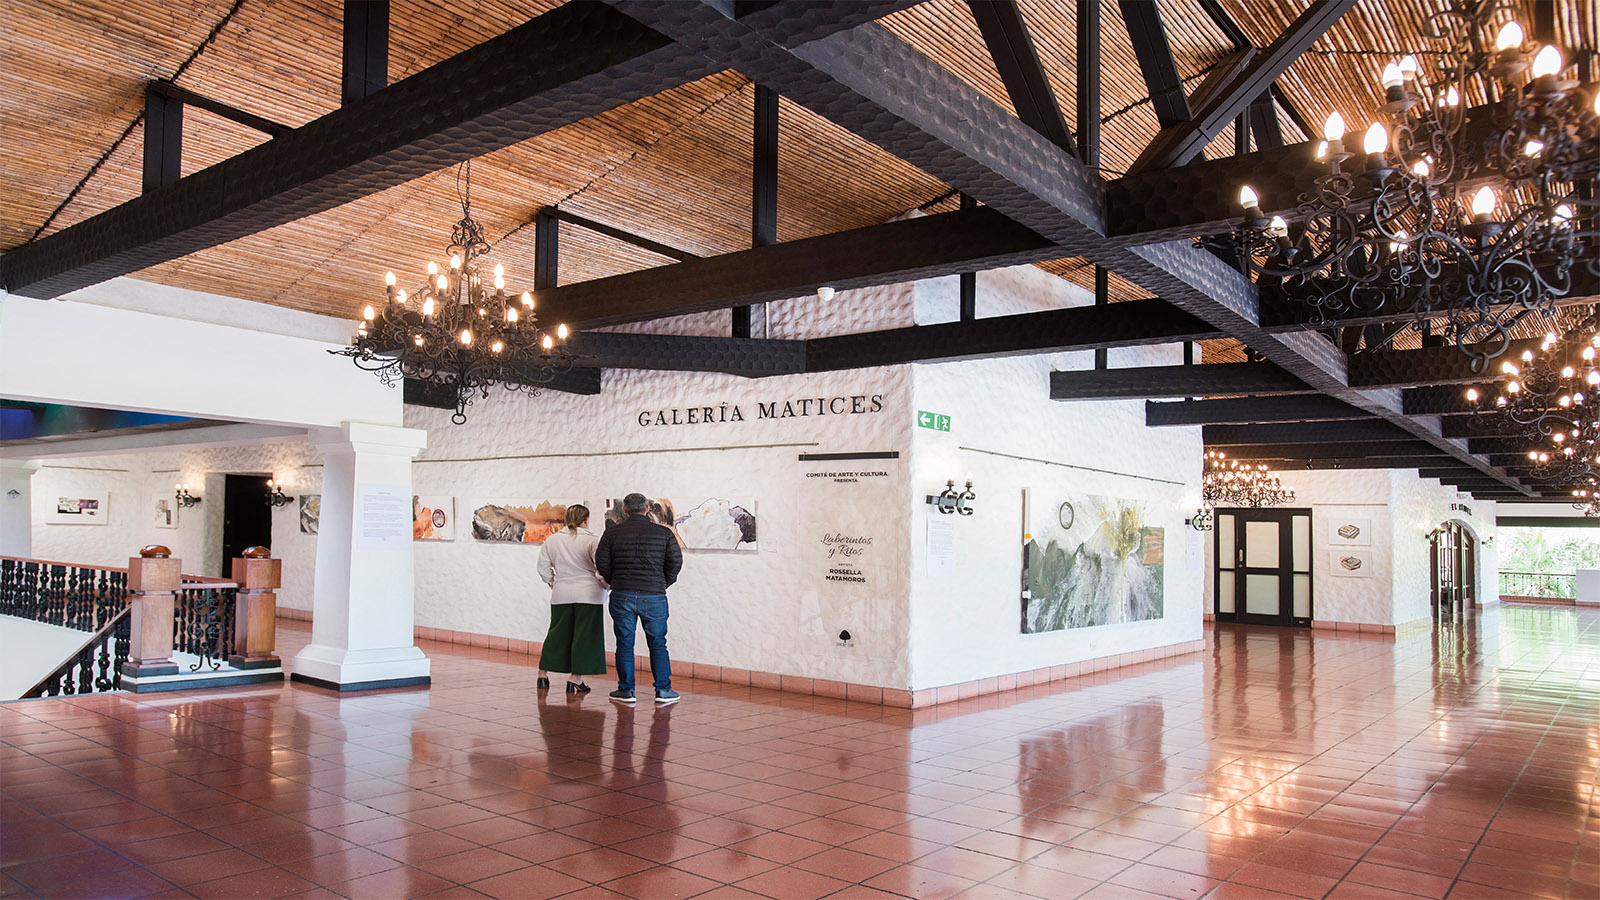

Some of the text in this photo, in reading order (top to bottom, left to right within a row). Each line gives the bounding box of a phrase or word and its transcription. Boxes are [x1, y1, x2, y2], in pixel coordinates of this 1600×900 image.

[638, 394, 884, 426] GALERÍA MATICES
[820, 533, 873, 546] Laberintos
[828, 544, 864, 559] y Ritos
